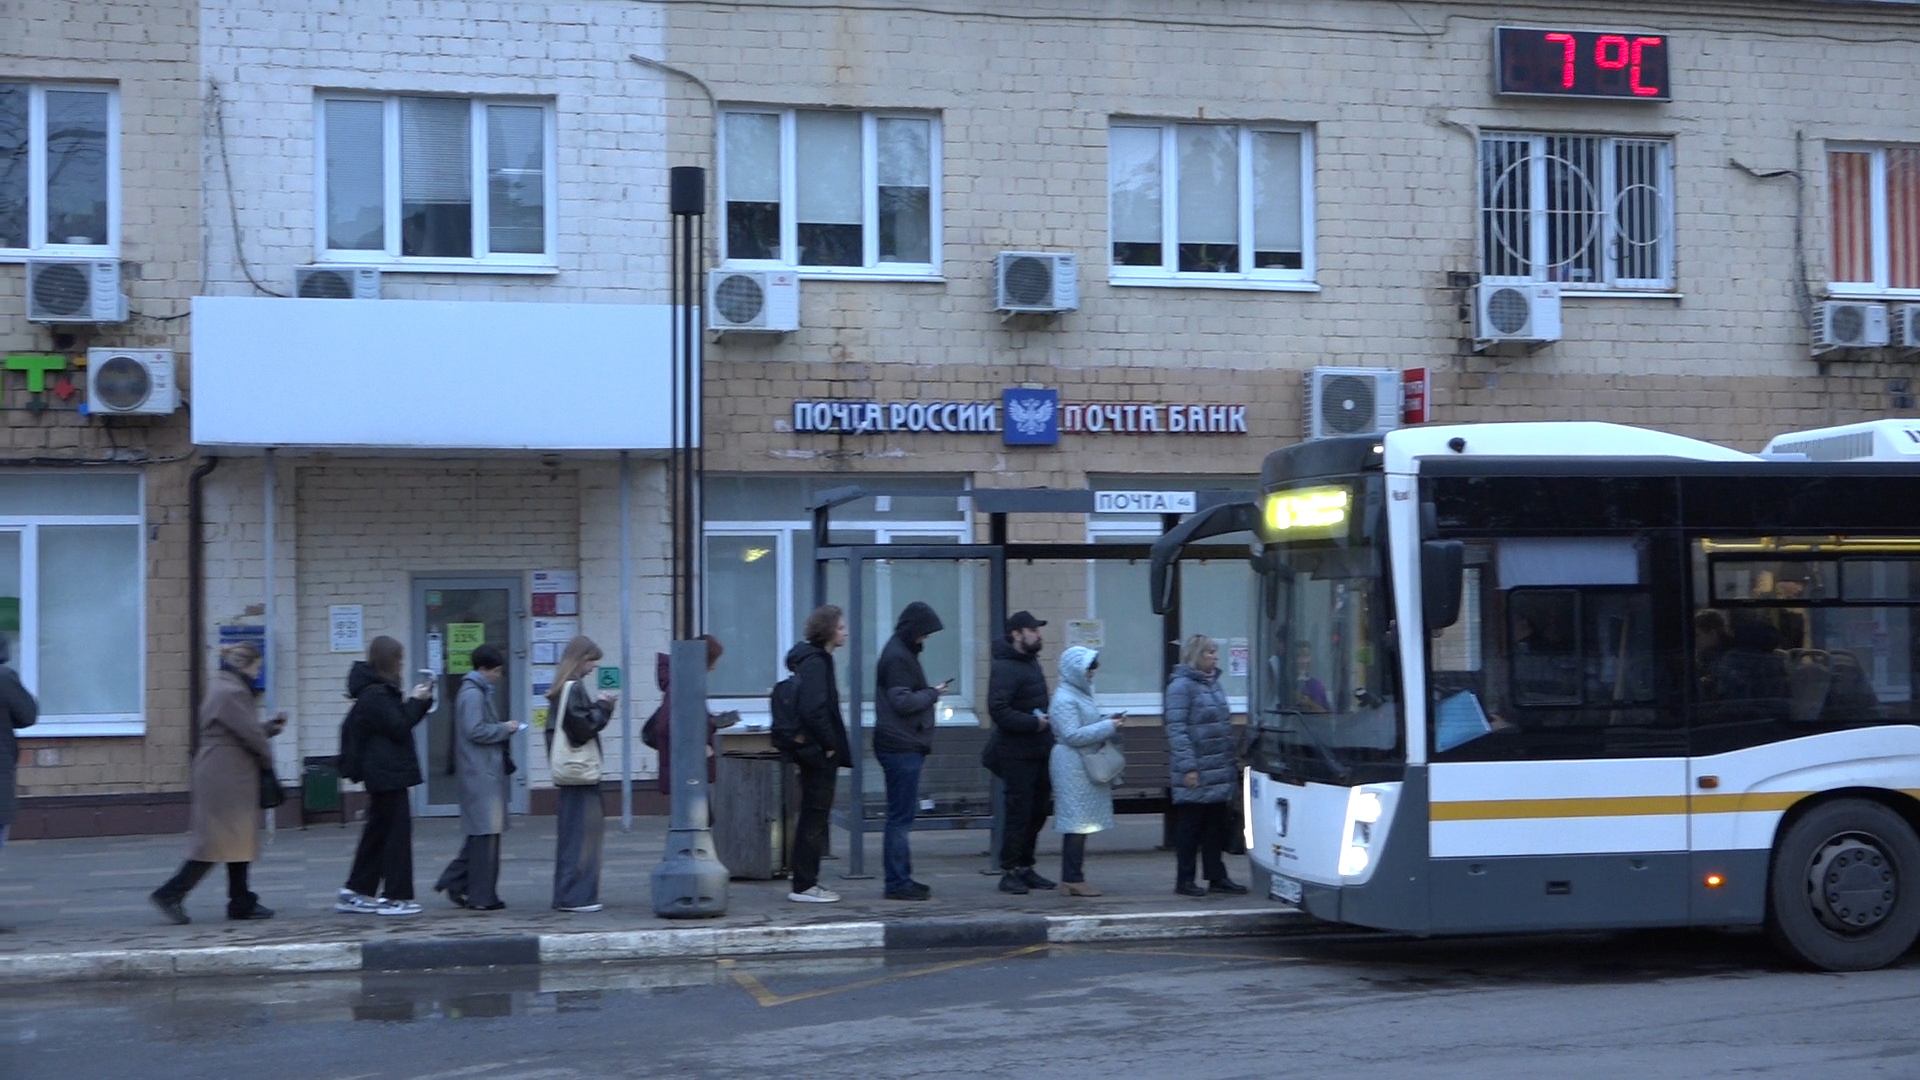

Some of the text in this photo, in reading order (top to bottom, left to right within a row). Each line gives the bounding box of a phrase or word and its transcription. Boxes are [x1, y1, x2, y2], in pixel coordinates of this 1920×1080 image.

[1545, 32, 1576, 88] 7
[794, 401, 997, 433] ПОЧТА РОССИИ
[1063, 404, 1249, 434] ПОЧТА БАНК
[1099, 493, 1168, 510] ПОЧТА
